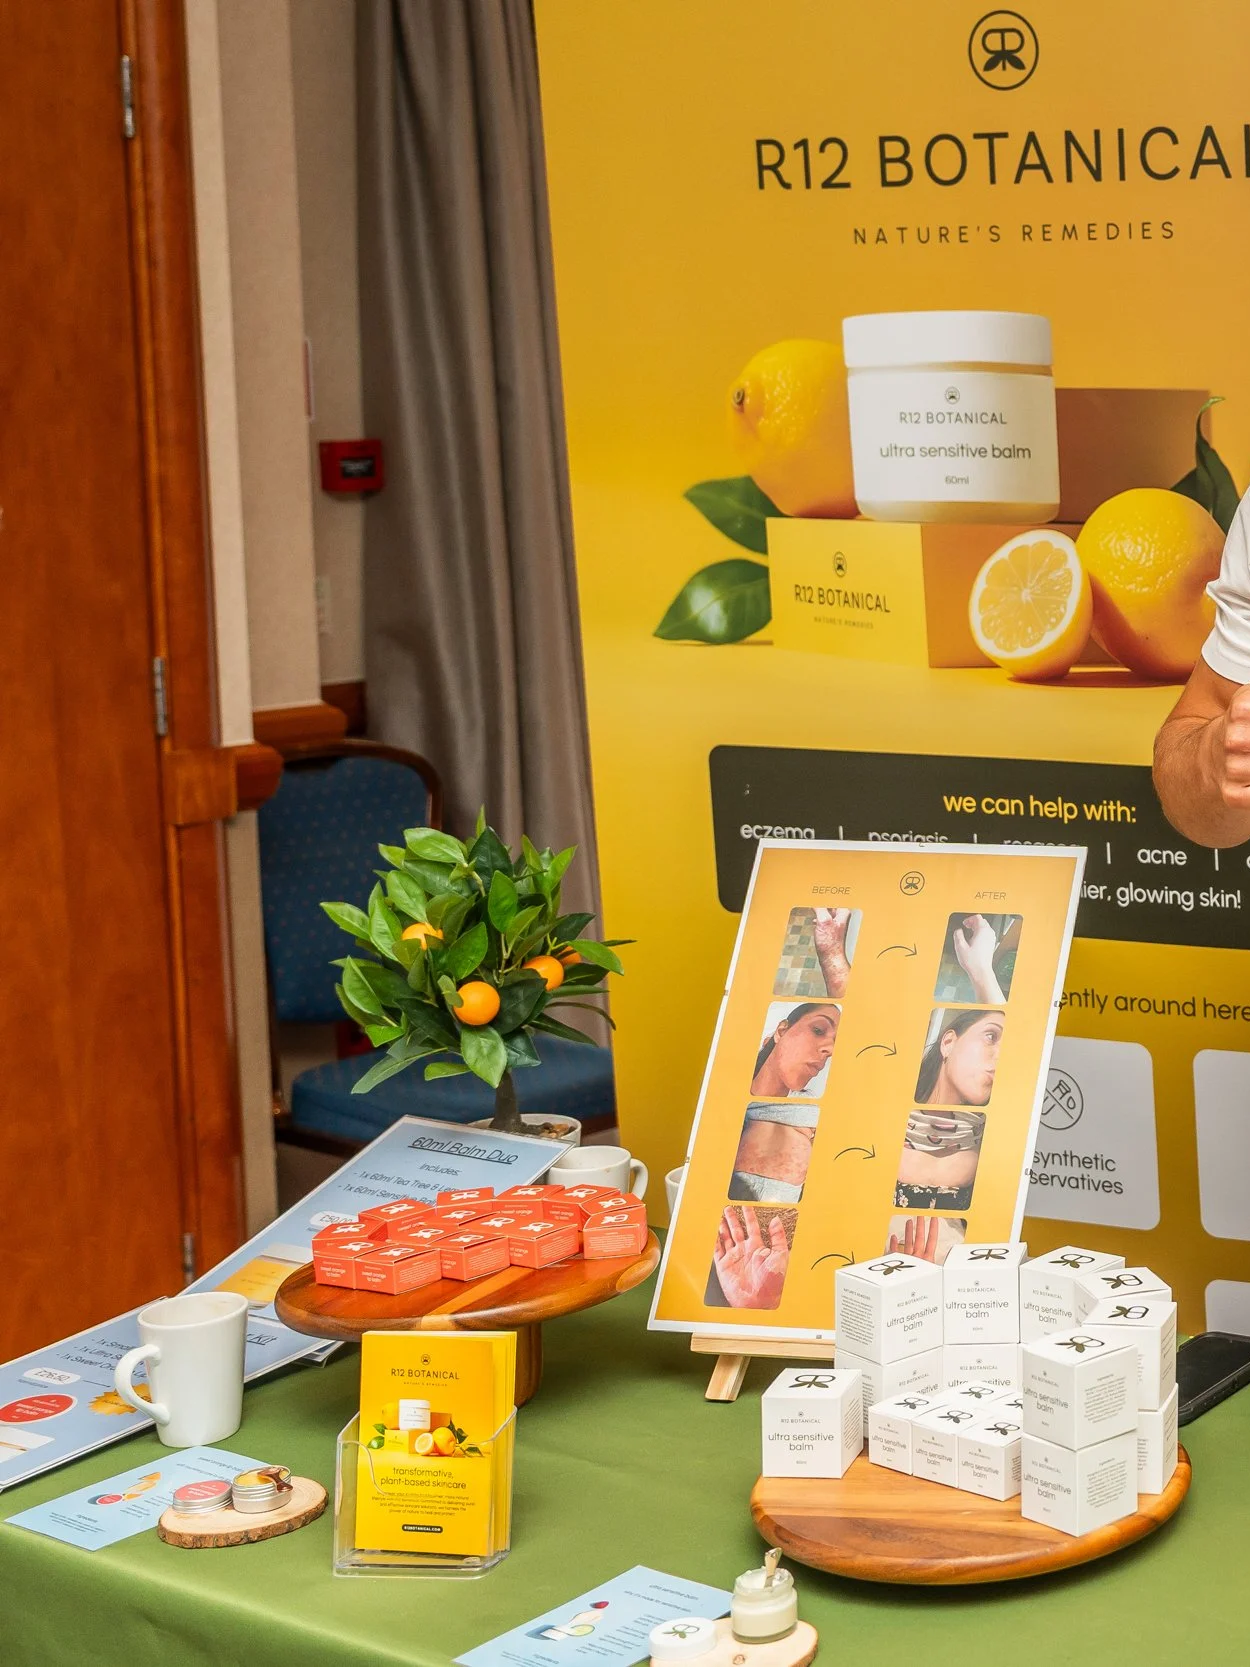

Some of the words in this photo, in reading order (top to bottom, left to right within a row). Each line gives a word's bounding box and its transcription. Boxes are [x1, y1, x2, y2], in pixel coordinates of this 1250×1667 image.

[755, 137, 852, 191] R12
[853, 225, 1002, 245] NATURE'S
[1022, 221, 1176, 242] REMEDIES
[899, 412, 921, 424] R12
[926, 411, 1007, 425] BOTANICAL
[880, 443, 915, 458] ultra
[920, 444, 987, 459] sensitive
[992, 444, 1032, 459] balm
[945, 475, 970, 485] 60ml
[794, 584, 814, 604] R12
[818, 588, 891, 613] BOTANICAL
[943, 795, 977, 813] we
[981, 797, 1024, 816] can
[1029, 795, 1078, 824] help
[1083, 800, 1137, 823] with:
[740, 822, 815, 840] eczema
[1137, 847, 1187, 866] acne
[811, 886, 851, 895] BEFORE
[974, 891, 1007, 900] AFTER
[1116, 882, 1194, 912] glowing
[1199, 886, 1242, 909] skin!
[1114, 993, 1197, 1017] around
[411, 1136, 450, 1152] 60ml
[448, 1140, 487, 1157] Balm
[486, 1149, 519, 1164] Duo
[394, 1176, 411, 1187] Tea
[411, 1179, 431, 1190] Tree
[945, 1300, 967, 1310] ultra
[968, 1300, 1009, 1310] sensitive
[1023, 1301, 1040, 1313] ultra
[1040, 1306, 1073, 1319] sensitive
[886, 1315, 905, 1328] ultra
[905, 1305, 938, 1322] sensitive
[965, 1309, 990, 1319] balm
[1038, 1313, 1057, 1325] balm
[903, 1319, 923, 1332] balm
[391, 1368, 405, 1377] R12
[407, 1369, 460, 1380] BOTANICAL
[1038, 1393, 1069, 1409] sensitive
[768, 1432, 791, 1442] ultra
[792, 1432, 834, 1442] sensitive
[789, 1442, 814, 1451] balm
[393, 1467, 454, 1479] transformative,
[380, 1477, 430, 1488] plant-based
[432, 1478, 466, 1489] skincare
[1023, 1472, 1039, 1485] ultra
[1039, 1477, 1072, 1494] sensitive
[1037, 1488, 1056, 1501] balm
